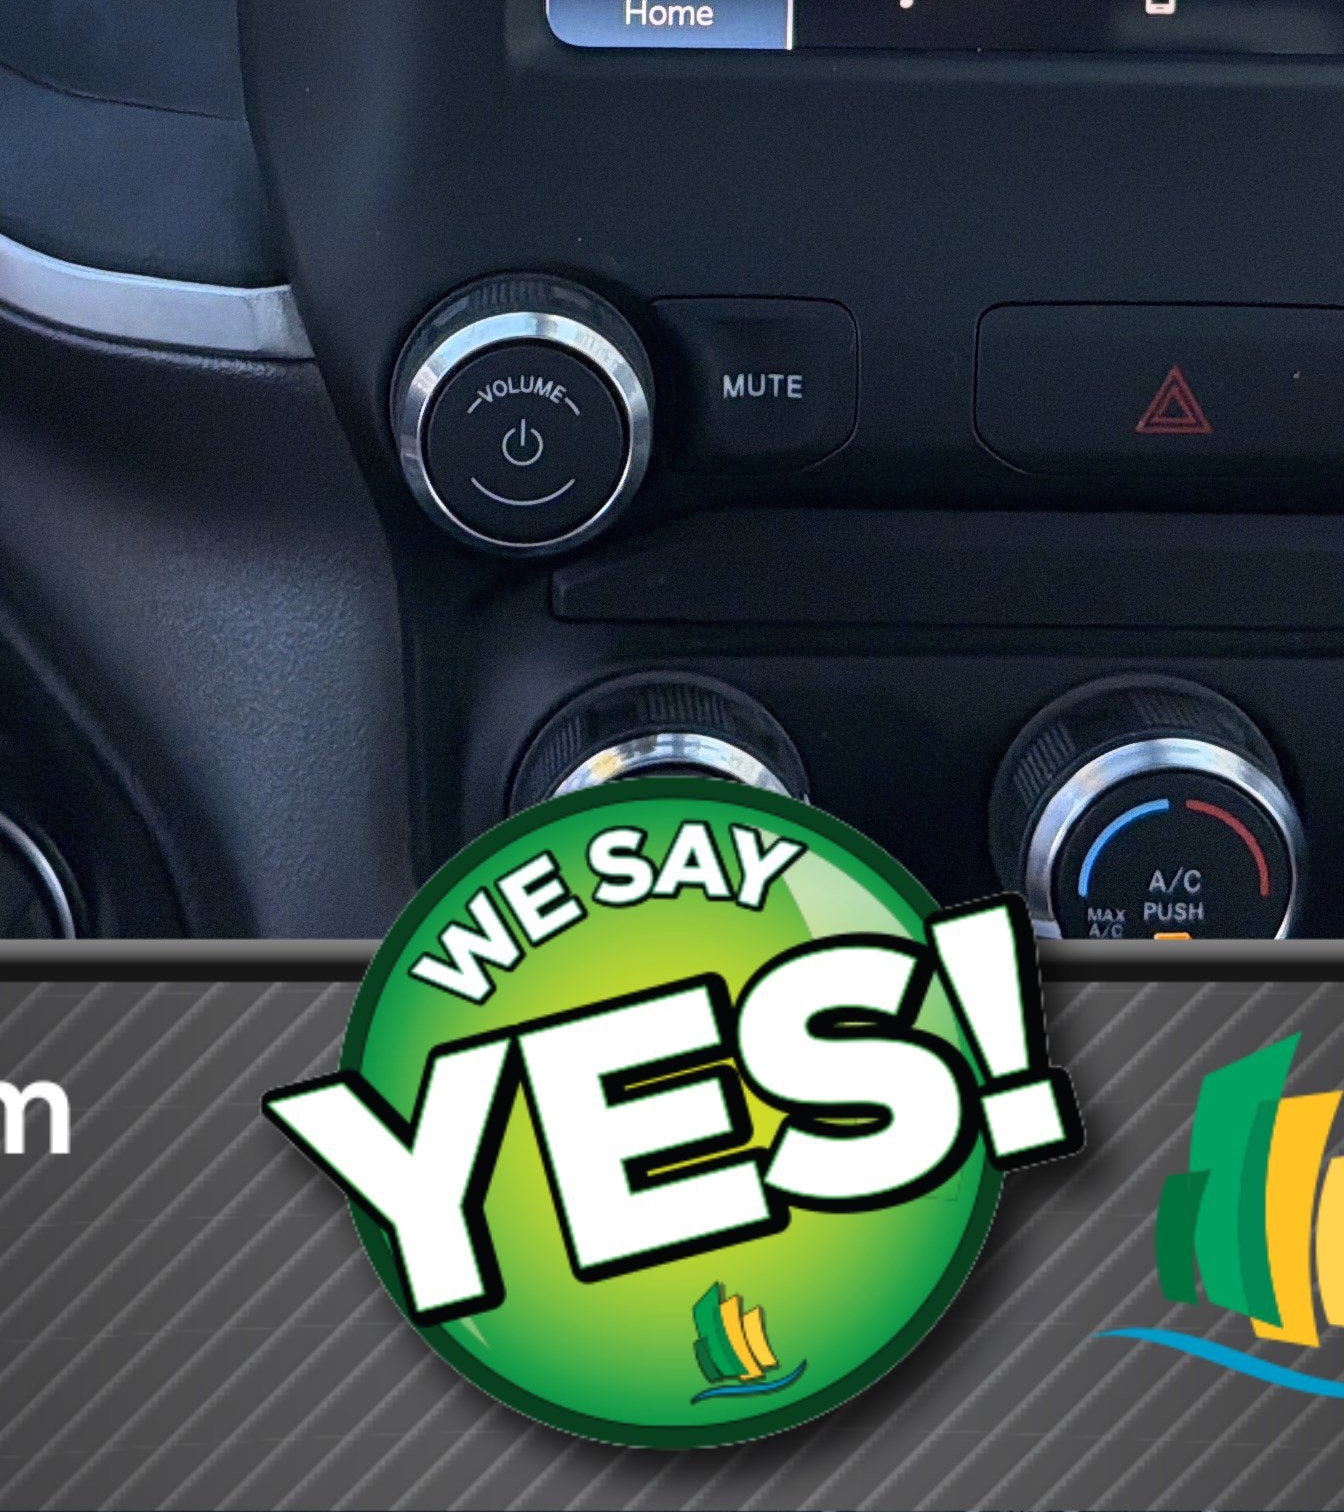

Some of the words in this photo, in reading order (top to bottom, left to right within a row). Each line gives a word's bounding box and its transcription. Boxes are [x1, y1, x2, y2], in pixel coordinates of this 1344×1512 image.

[624, 0, 715, 27] Home
[477, 375, 568, 406] VOLUME
[722, 373, 804, 400] MUTE
[1148, 866, 1202, 894] A/C
[1087, 907, 1126, 923] MAX
[1142, 901, 1205, 921] PUSH
[1088, 922, 1123, 938] A/C
